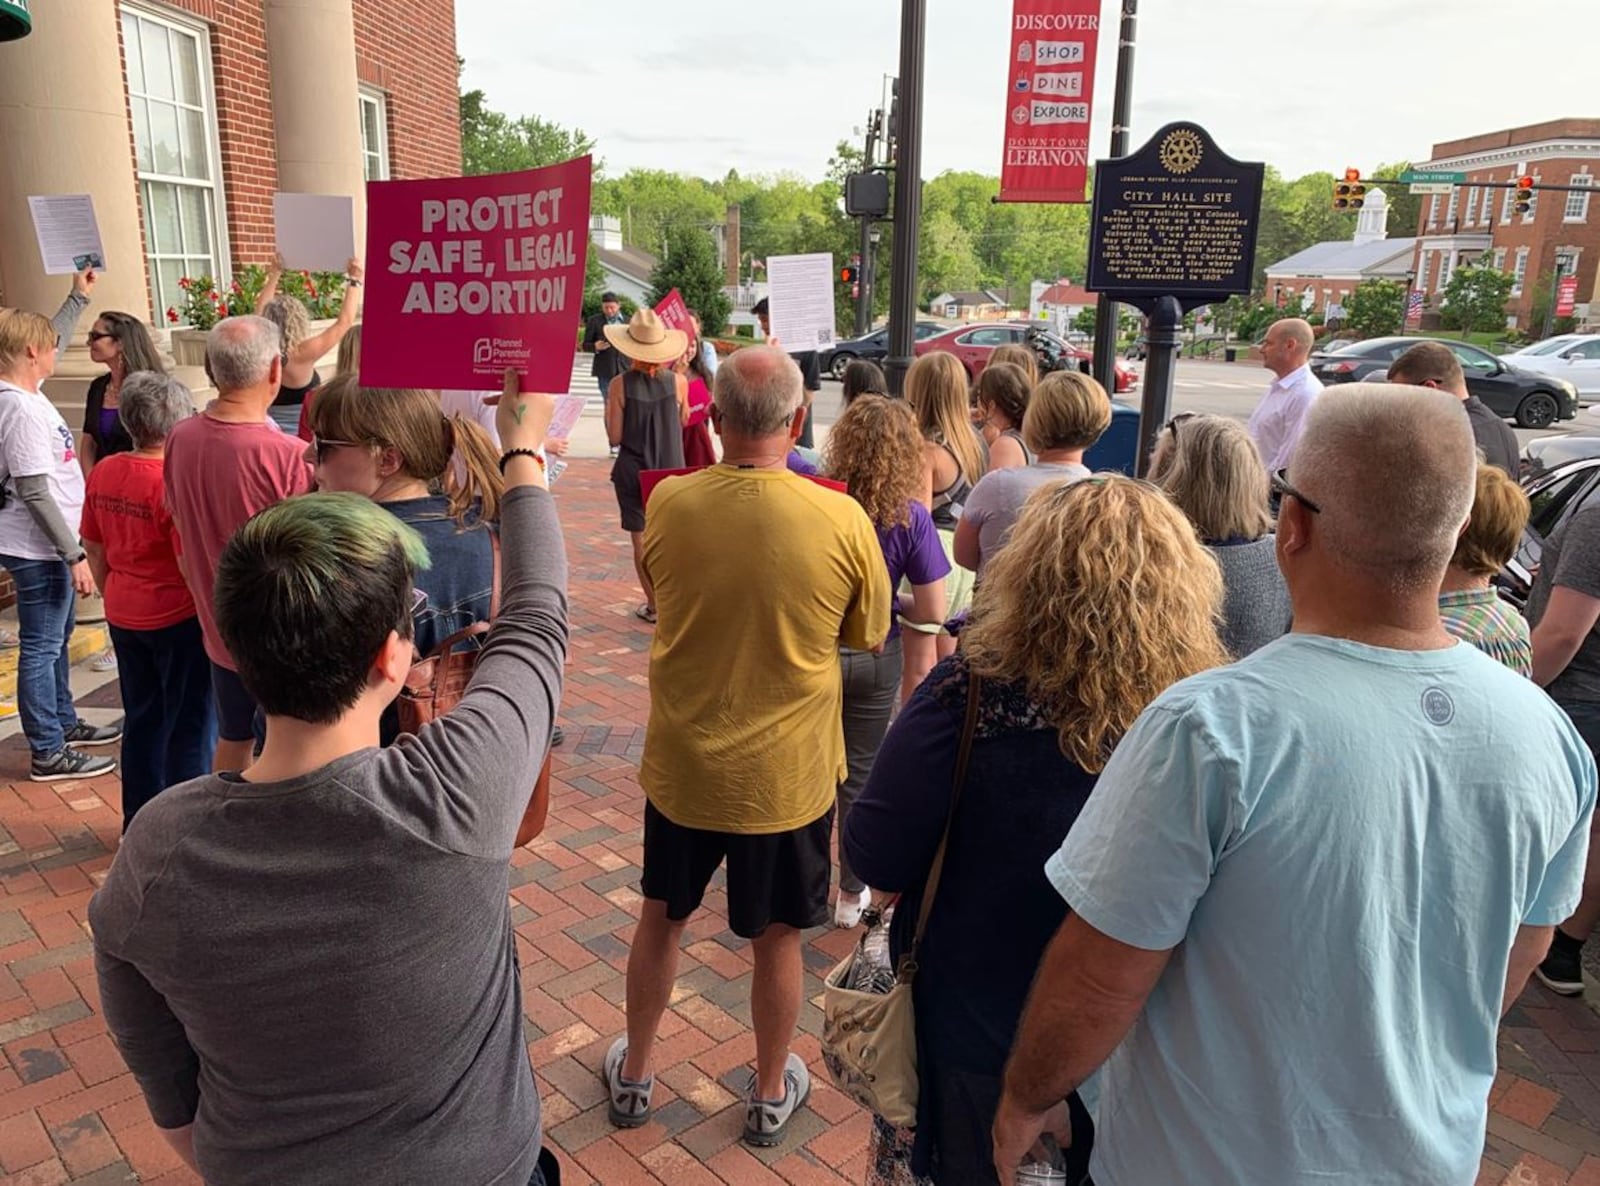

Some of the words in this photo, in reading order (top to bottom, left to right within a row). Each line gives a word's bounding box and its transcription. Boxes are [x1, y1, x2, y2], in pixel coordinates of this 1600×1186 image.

[1015, 14, 1098, 30] DISCOVER
[1038, 46, 1080, 59] SHOP
[1038, 78, 1078, 90] DINE
[1034, 106, 1086, 118] EXPLORE
[1008, 138, 1088, 146] DOWNTOWN
[1006, 150, 1086, 166] LEBANON
[1123, 191, 1154, 201] CITY
[1162, 192, 1196, 202] HALL
[1203, 193, 1232, 202] SITE
[422, 188, 562, 232] PROTECT
[388, 239, 496, 278] SAFE,
[505, 230, 576, 272] LEGAL
[401, 276, 566, 314] ABORTION
